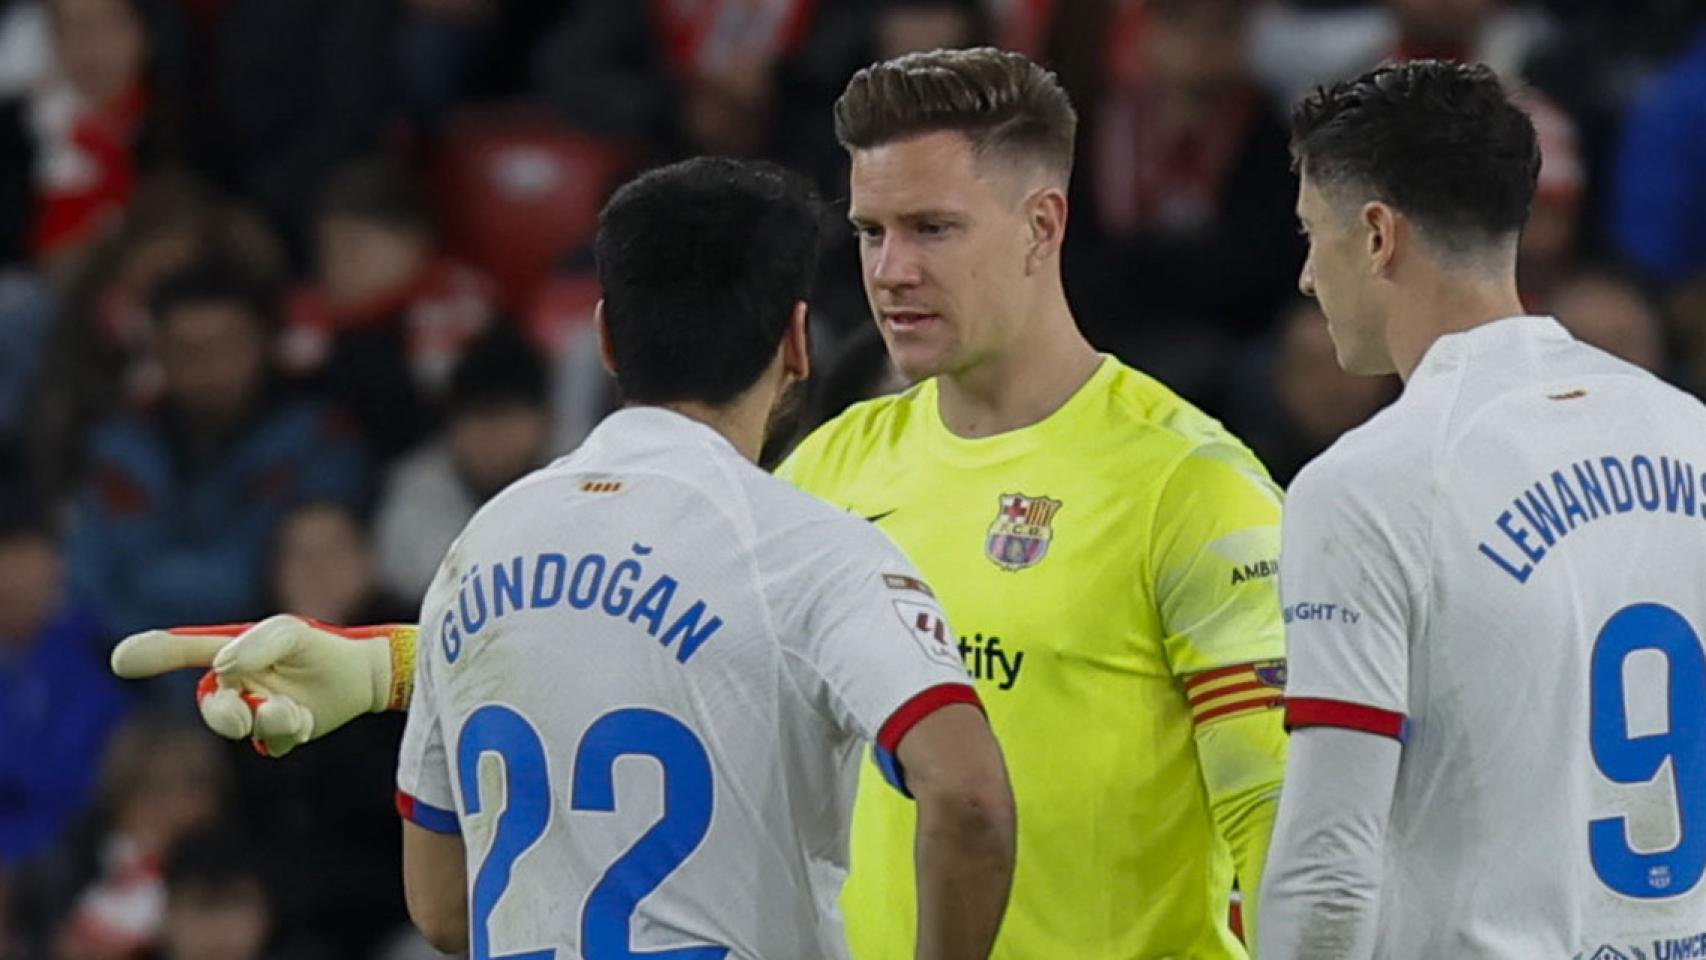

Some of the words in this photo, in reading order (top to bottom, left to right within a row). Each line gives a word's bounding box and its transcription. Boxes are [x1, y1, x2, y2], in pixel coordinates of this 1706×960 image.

[1478, 454, 1706, 584] LEWANDOW
[442, 542, 724, 664] GÜNDOĞAN
[958, 632, 1024, 690] tify
[1341, 608, 1360, 624] tv
[1588, 602, 1706, 899] 9
[457, 704, 731, 960] 22
